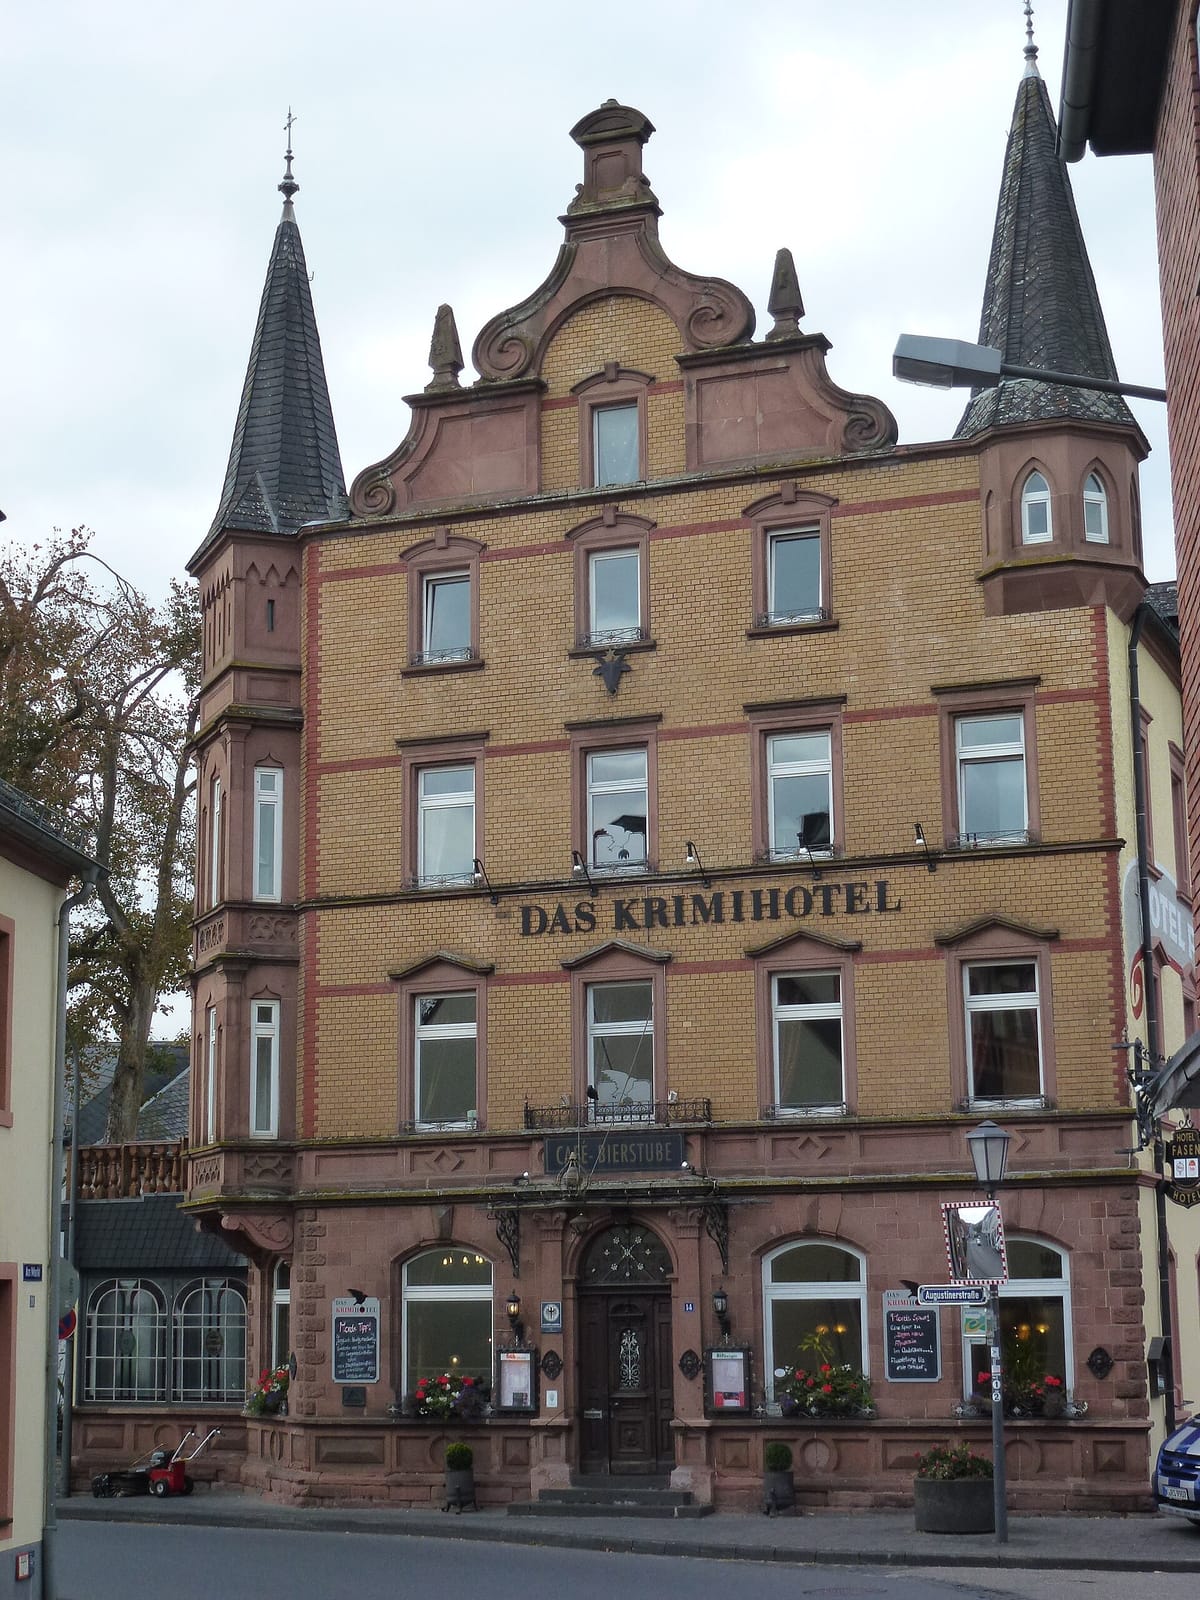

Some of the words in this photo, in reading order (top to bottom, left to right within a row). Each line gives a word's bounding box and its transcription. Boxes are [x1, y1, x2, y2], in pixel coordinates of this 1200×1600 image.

[520, 901, 597, 937] DAS
[612, 880, 902, 931] KRIMIHOTEL
[1176, 1131, 1196, 1142] HOTEL
[600, 1142, 672, 1164] BIERSTUBE
[1172, 1143, 1200, 1157] FASEN
[925, 1290, 980, 1302] Augustinerstraße
